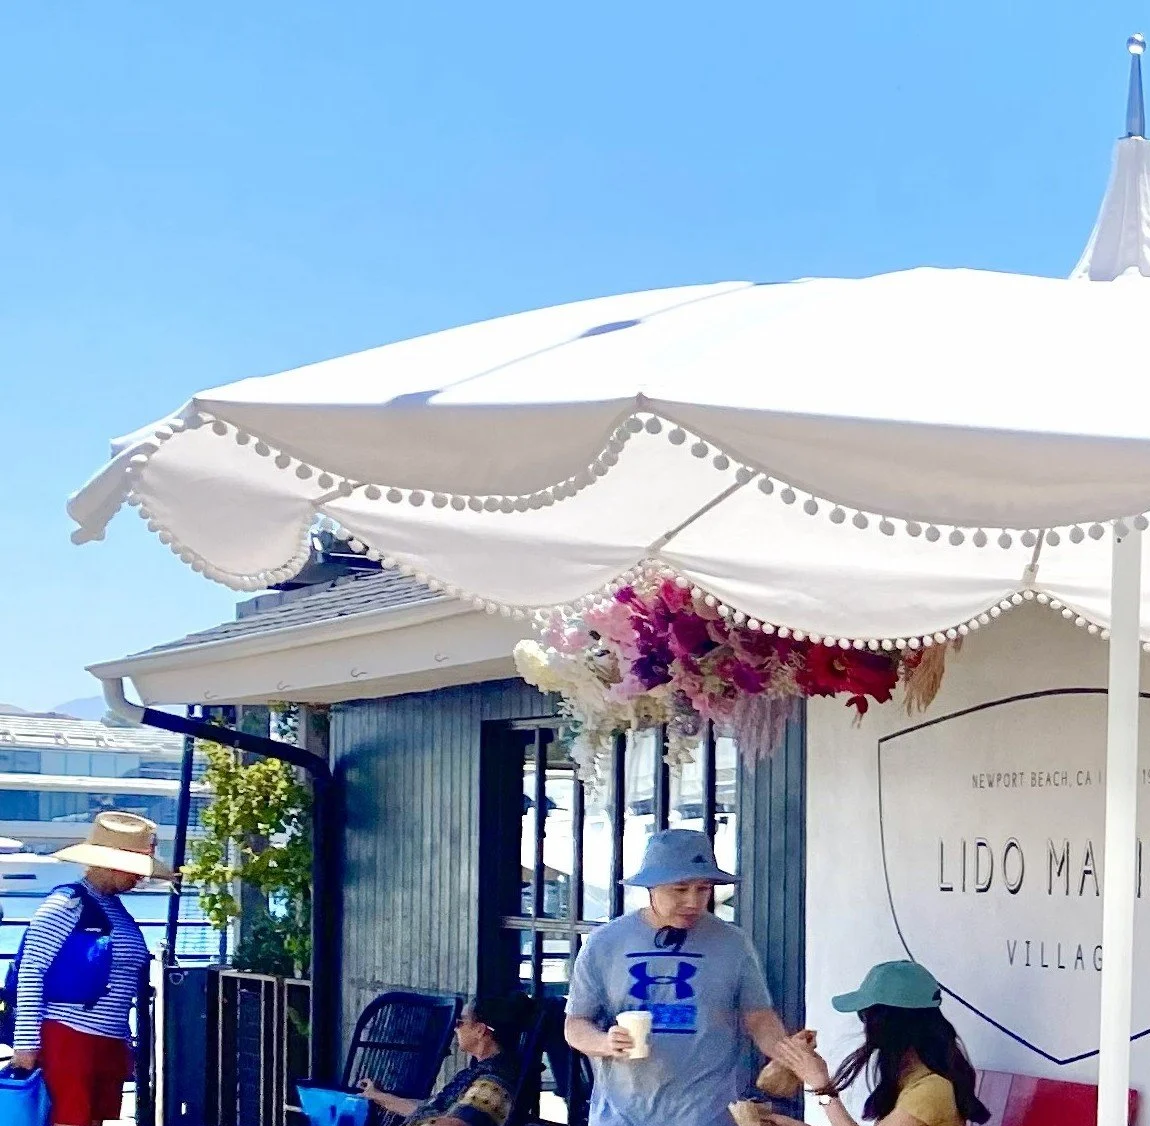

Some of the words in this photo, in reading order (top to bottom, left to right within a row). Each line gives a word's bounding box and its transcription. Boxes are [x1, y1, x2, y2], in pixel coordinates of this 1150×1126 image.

[972, 772, 1024, 789] NEWPORT
[1030, 771, 1073, 788] BEACH,
[1076, 770, 1092, 786] CA
[937, 836, 1025, 895] LIDO
[1006, 939, 1103, 971] VILLAG
